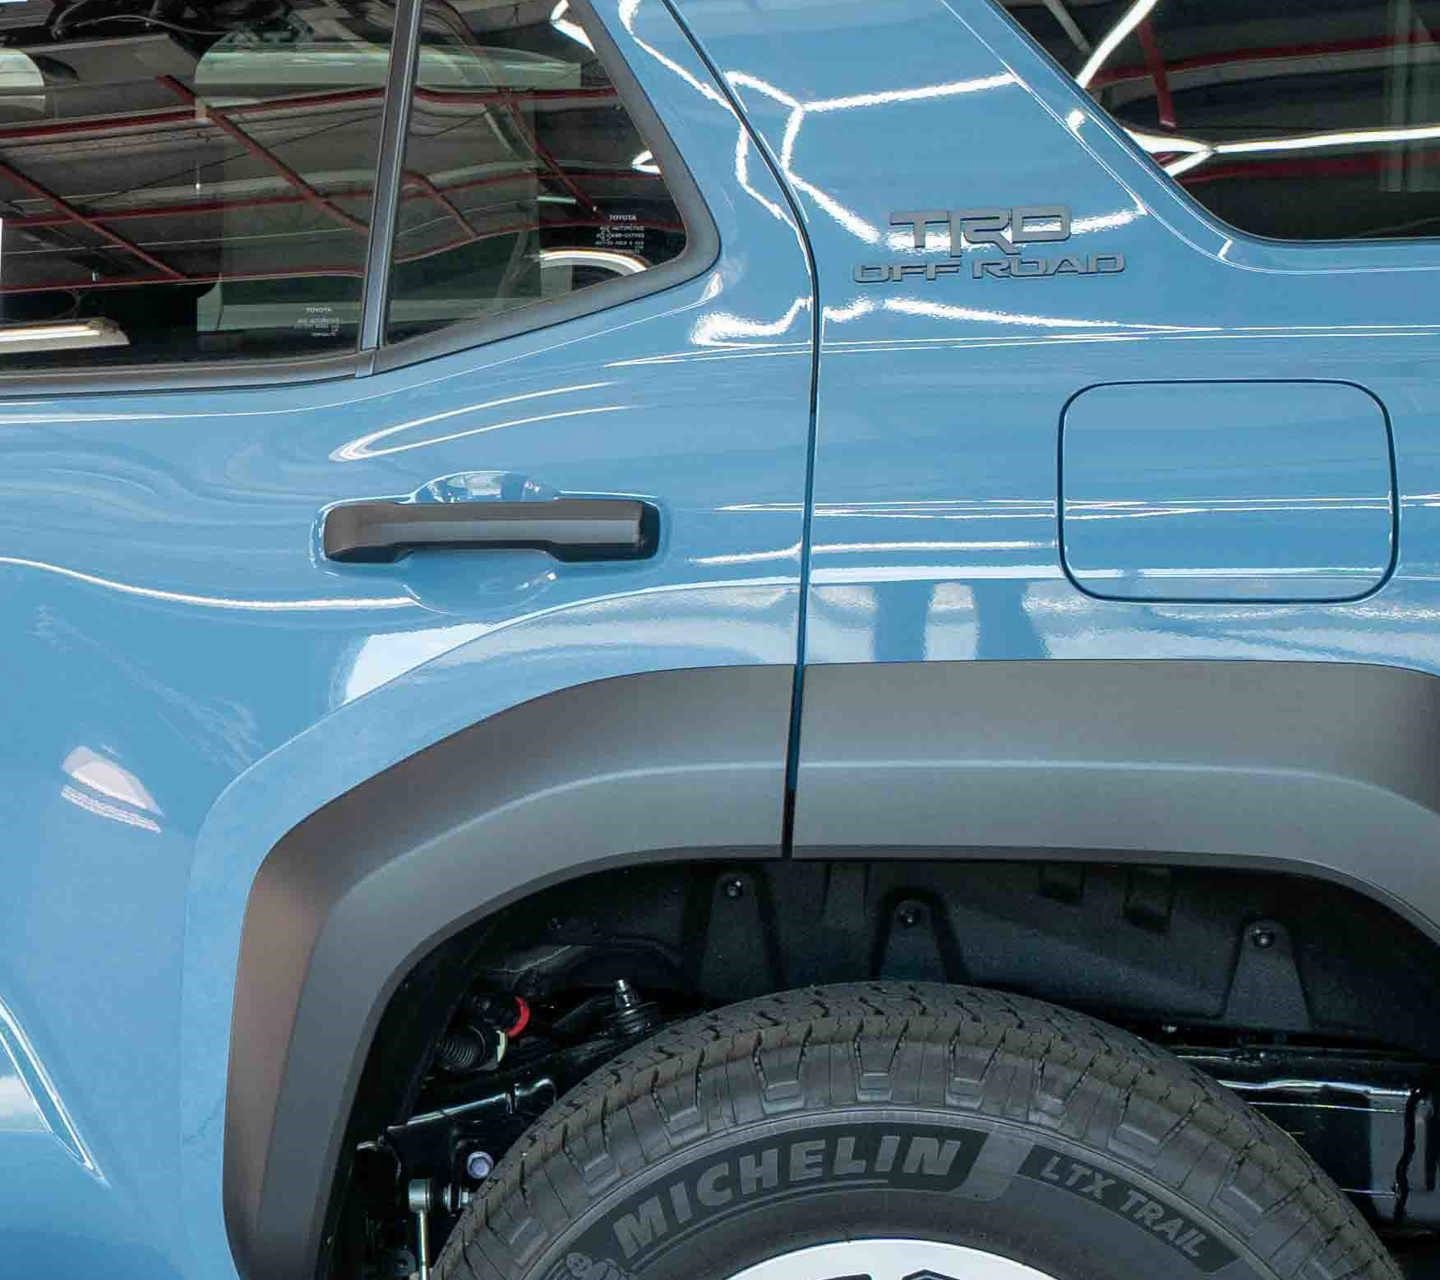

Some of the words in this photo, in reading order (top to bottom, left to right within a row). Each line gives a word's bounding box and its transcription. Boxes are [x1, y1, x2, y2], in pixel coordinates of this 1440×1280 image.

[853, 261, 961, 283] OFF
[972, 253, 1125, 280] ROAD
[889, 205, 1072, 258] TRD
[612, 1135, 962, 1258] MICHELIN
[1040, 1156, 1116, 1200] LTX
[1120, 1190, 1207, 1257] TRAIL
